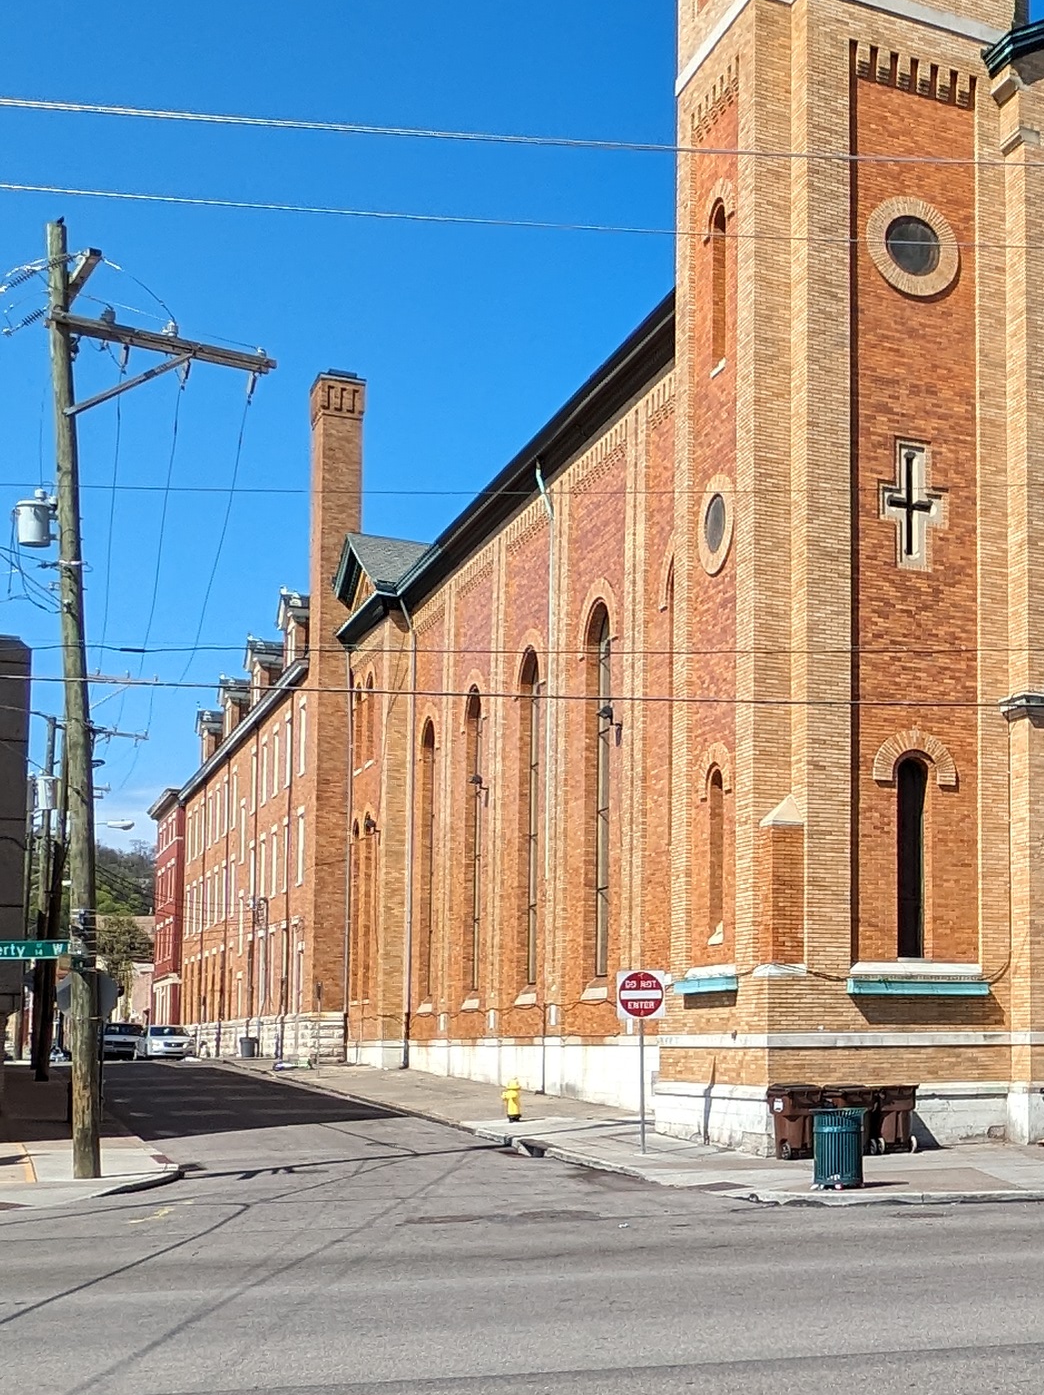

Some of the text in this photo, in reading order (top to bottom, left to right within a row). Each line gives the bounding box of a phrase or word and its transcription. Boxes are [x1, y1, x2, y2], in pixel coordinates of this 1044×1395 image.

[625, 980, 657, 989] DO NOT
[627, 1001, 654, 1010] ENTER
